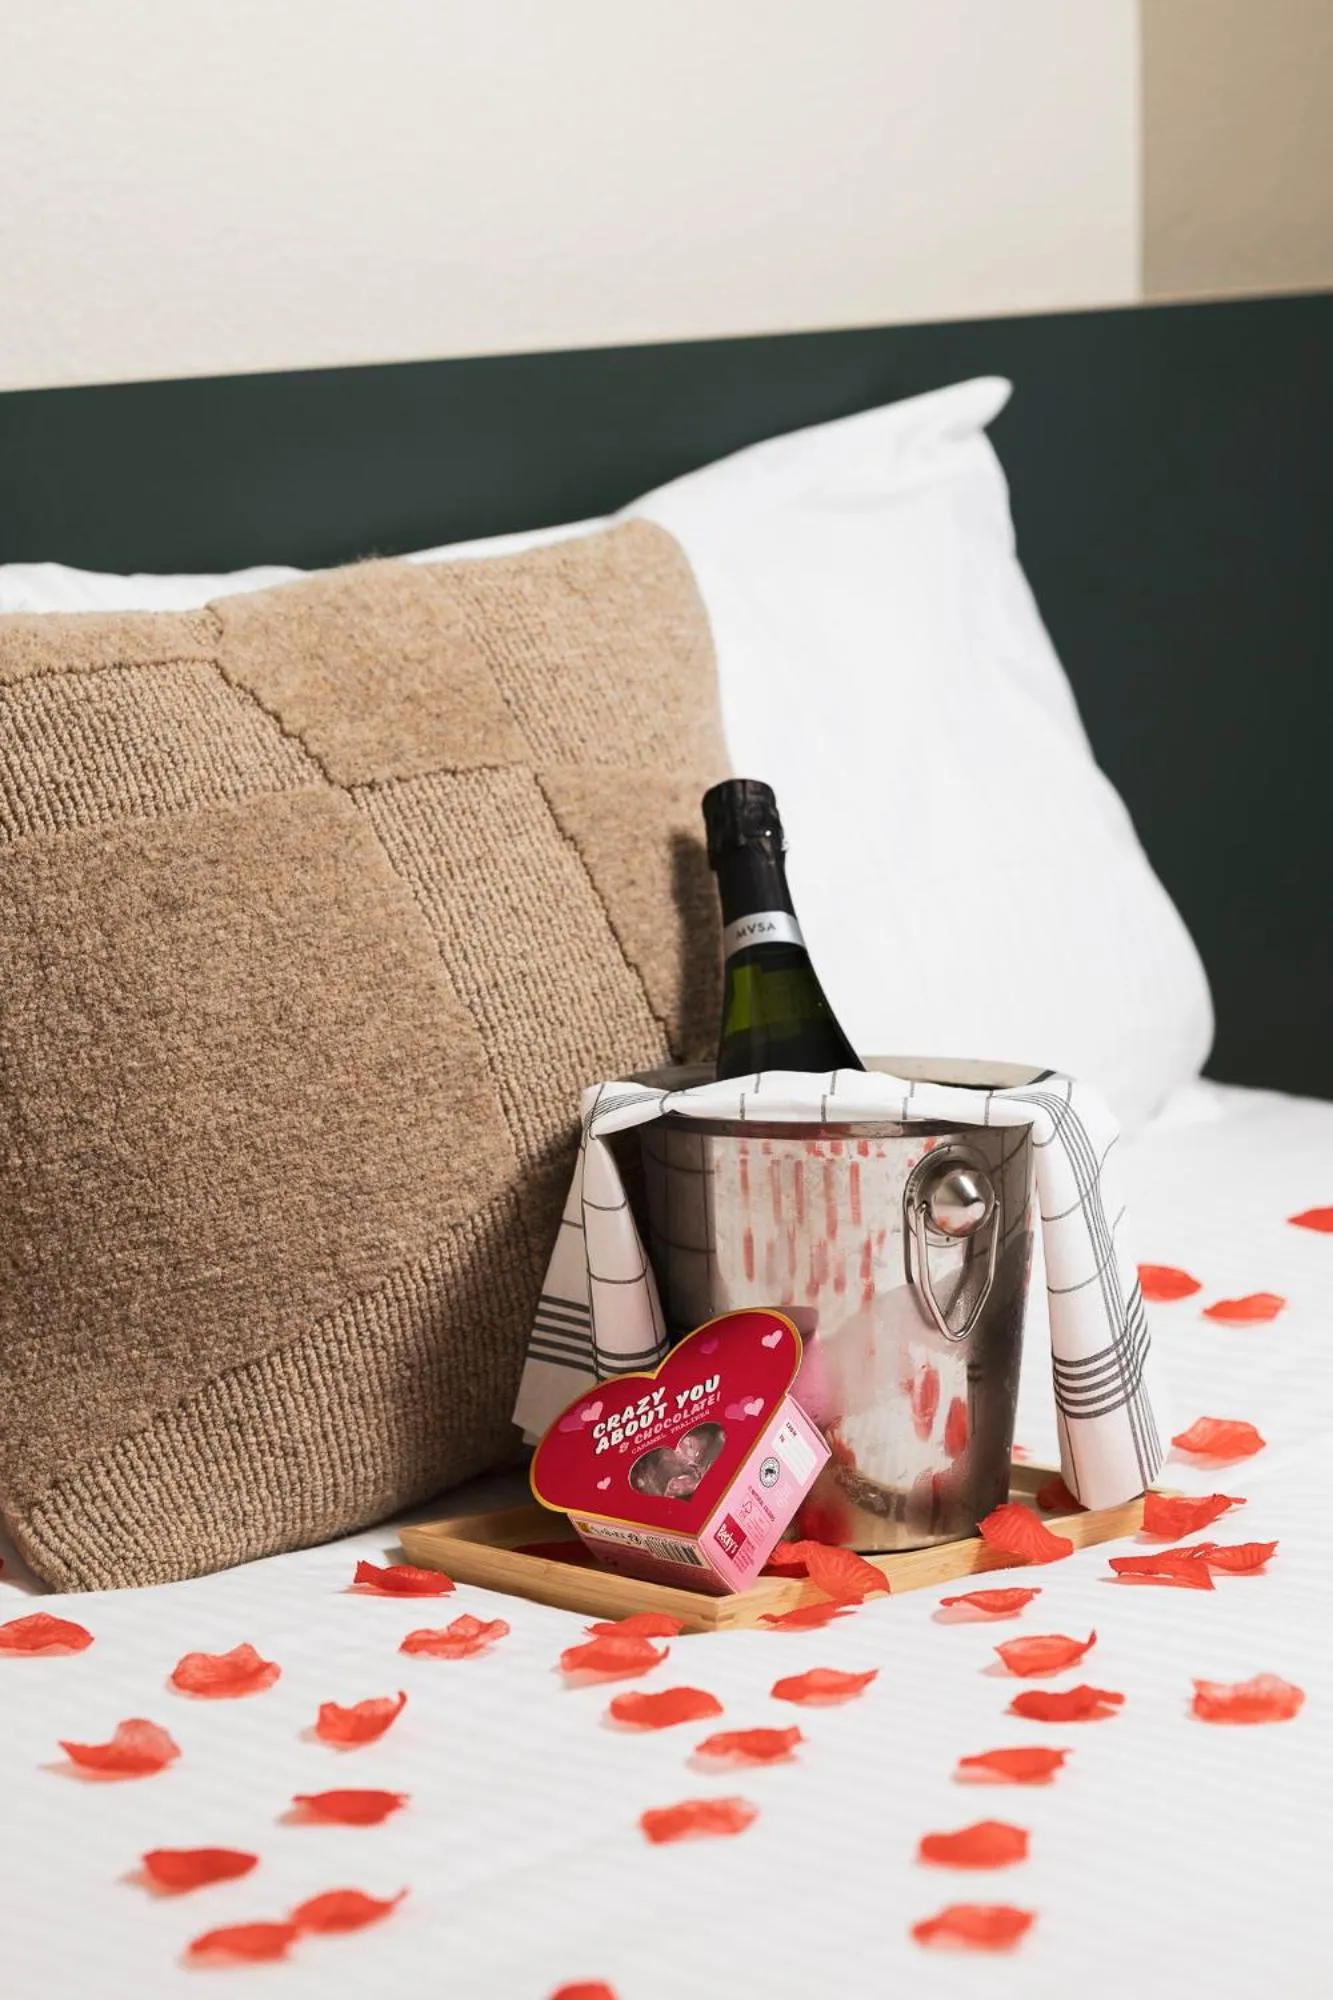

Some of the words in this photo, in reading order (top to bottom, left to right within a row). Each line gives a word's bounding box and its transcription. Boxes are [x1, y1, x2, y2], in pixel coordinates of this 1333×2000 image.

[735, 921, 777, 940] MVSA
[592, 1386, 666, 1439] CRAZY
[595, 1402, 668, 1455] ABOUT
[675, 1374, 720, 1409] YOU
[634, 1391, 721, 1445] CHOCOLATE!
